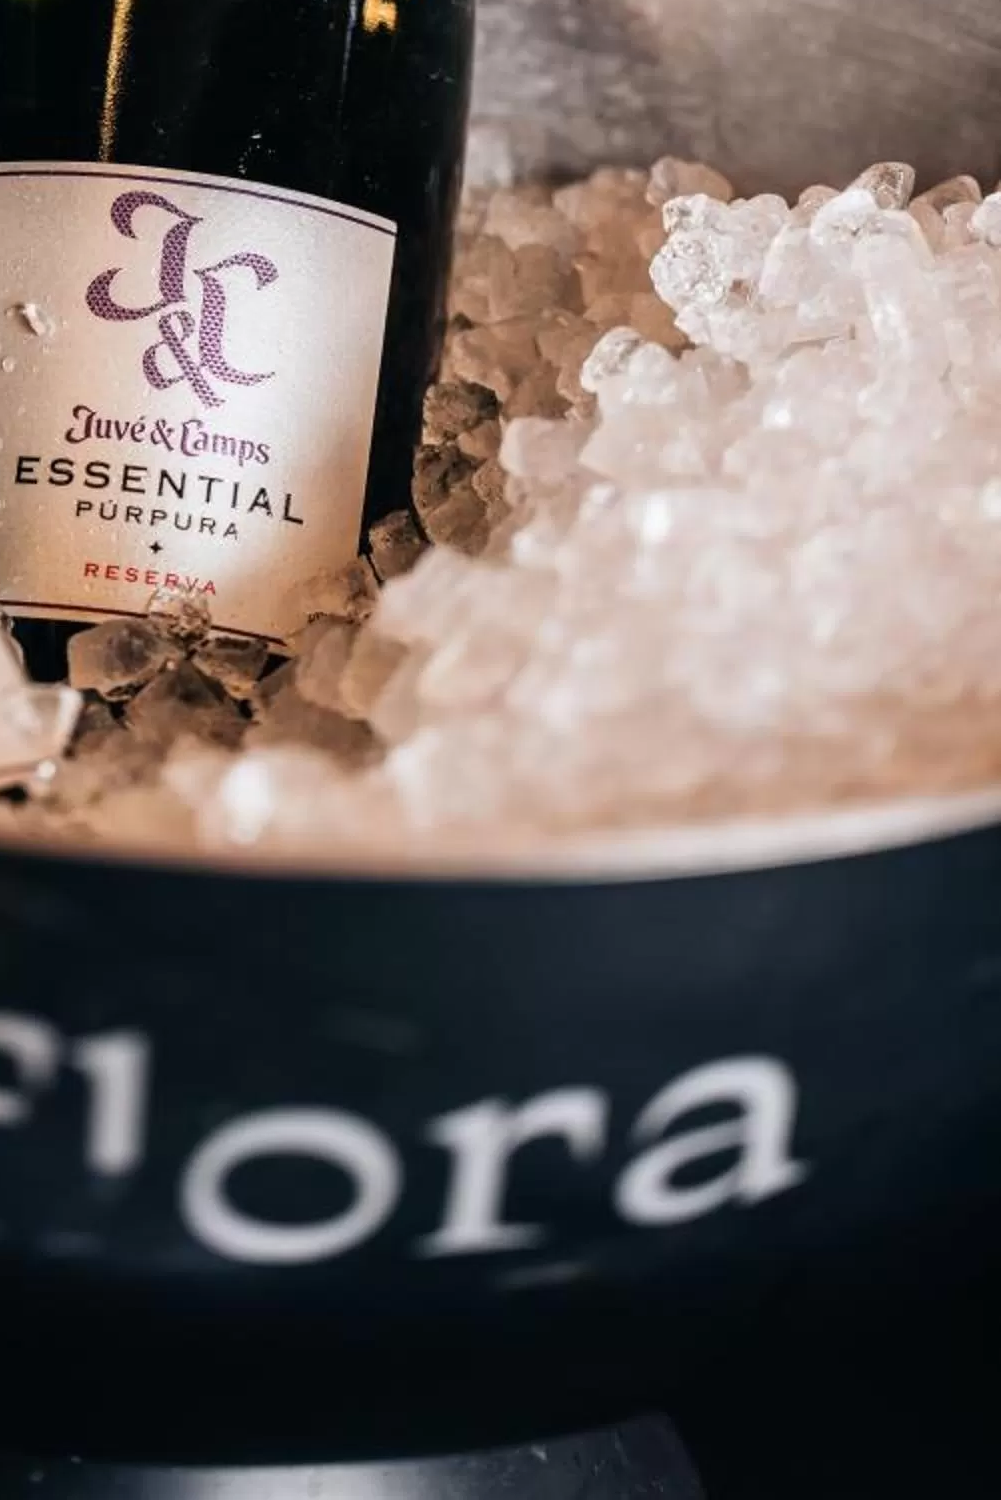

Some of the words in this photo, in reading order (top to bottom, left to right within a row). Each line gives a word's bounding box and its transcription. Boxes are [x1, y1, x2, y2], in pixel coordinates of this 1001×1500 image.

[14, 455, 305, 526] ESSENTIAL
[75, 499, 239, 540] PÚRPURA
[84, 562, 217, 596] RESERVA
